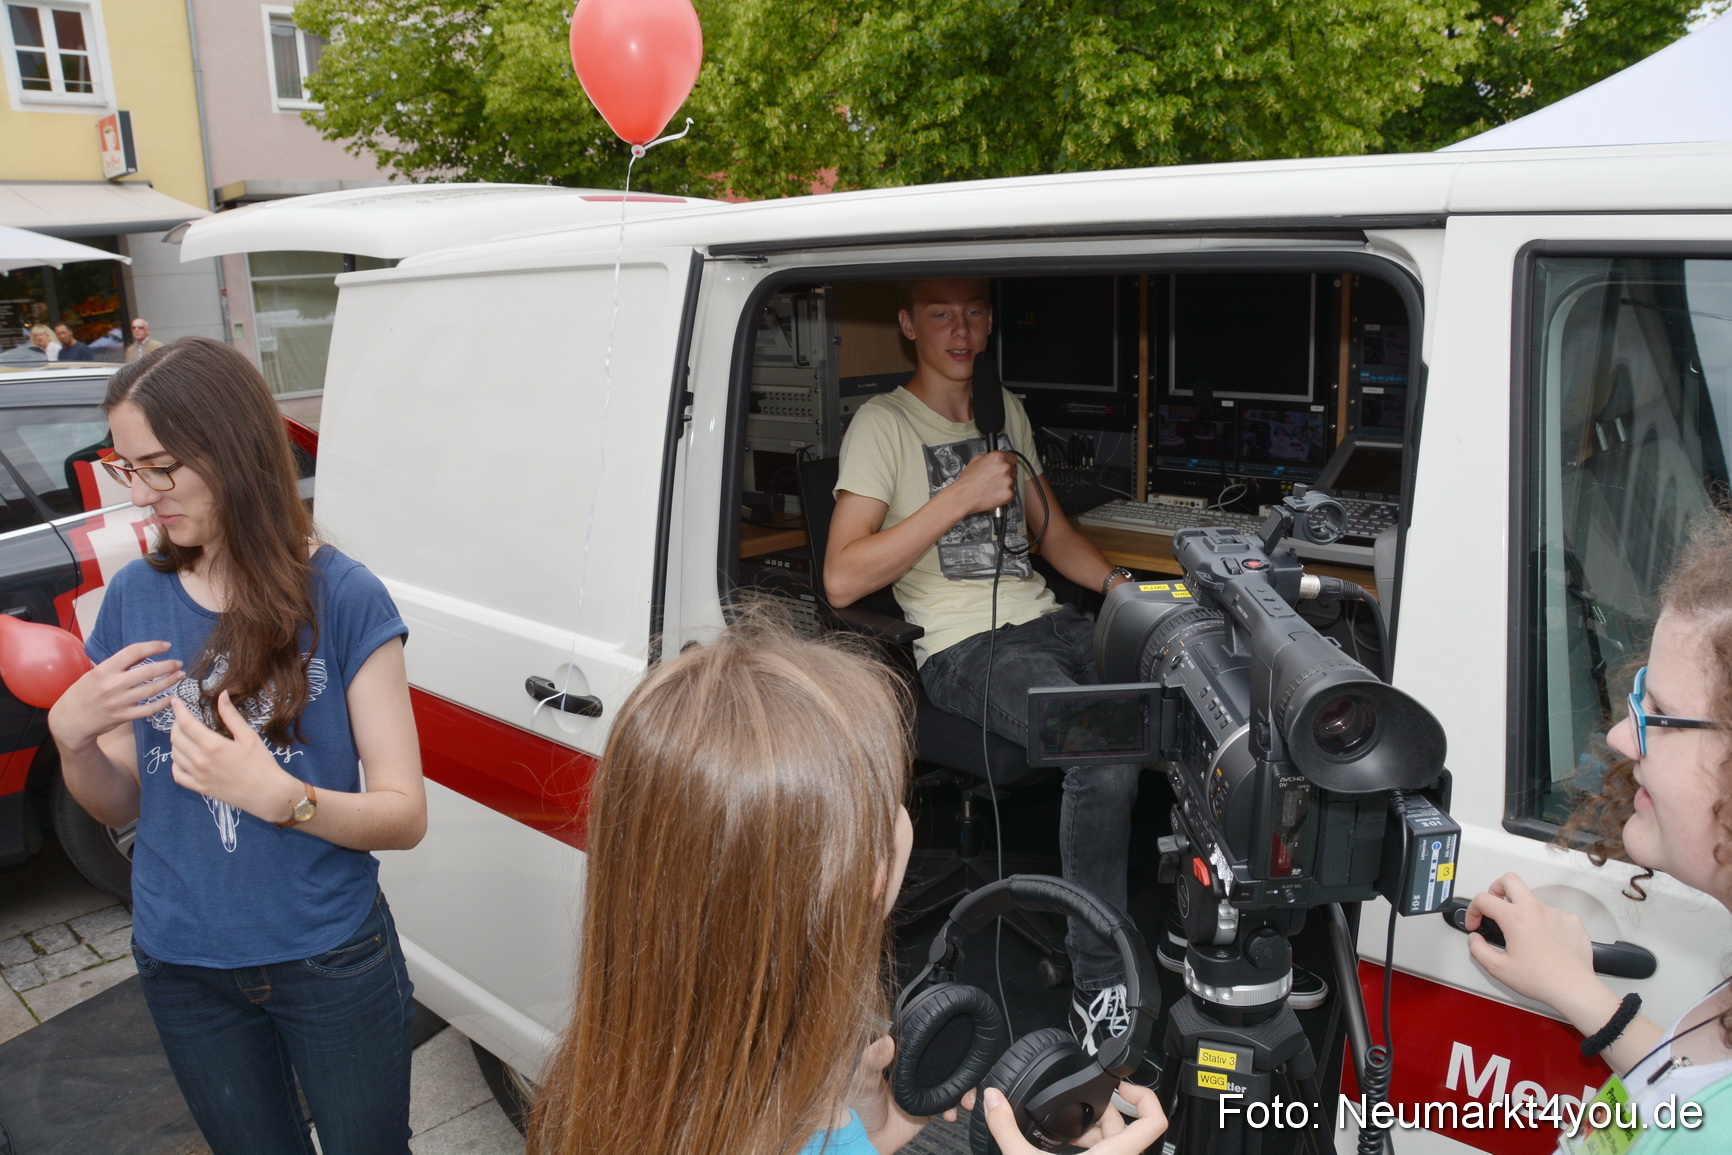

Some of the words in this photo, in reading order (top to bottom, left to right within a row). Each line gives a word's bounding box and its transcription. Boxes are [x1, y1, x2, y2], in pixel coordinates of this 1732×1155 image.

[1443, 867, 1450, 877] 3
[1202, 1052, 1227, 1064] Stativ
[1229, 1057, 1235, 1066] 3
[1200, 1075, 1225, 1086] WGG
